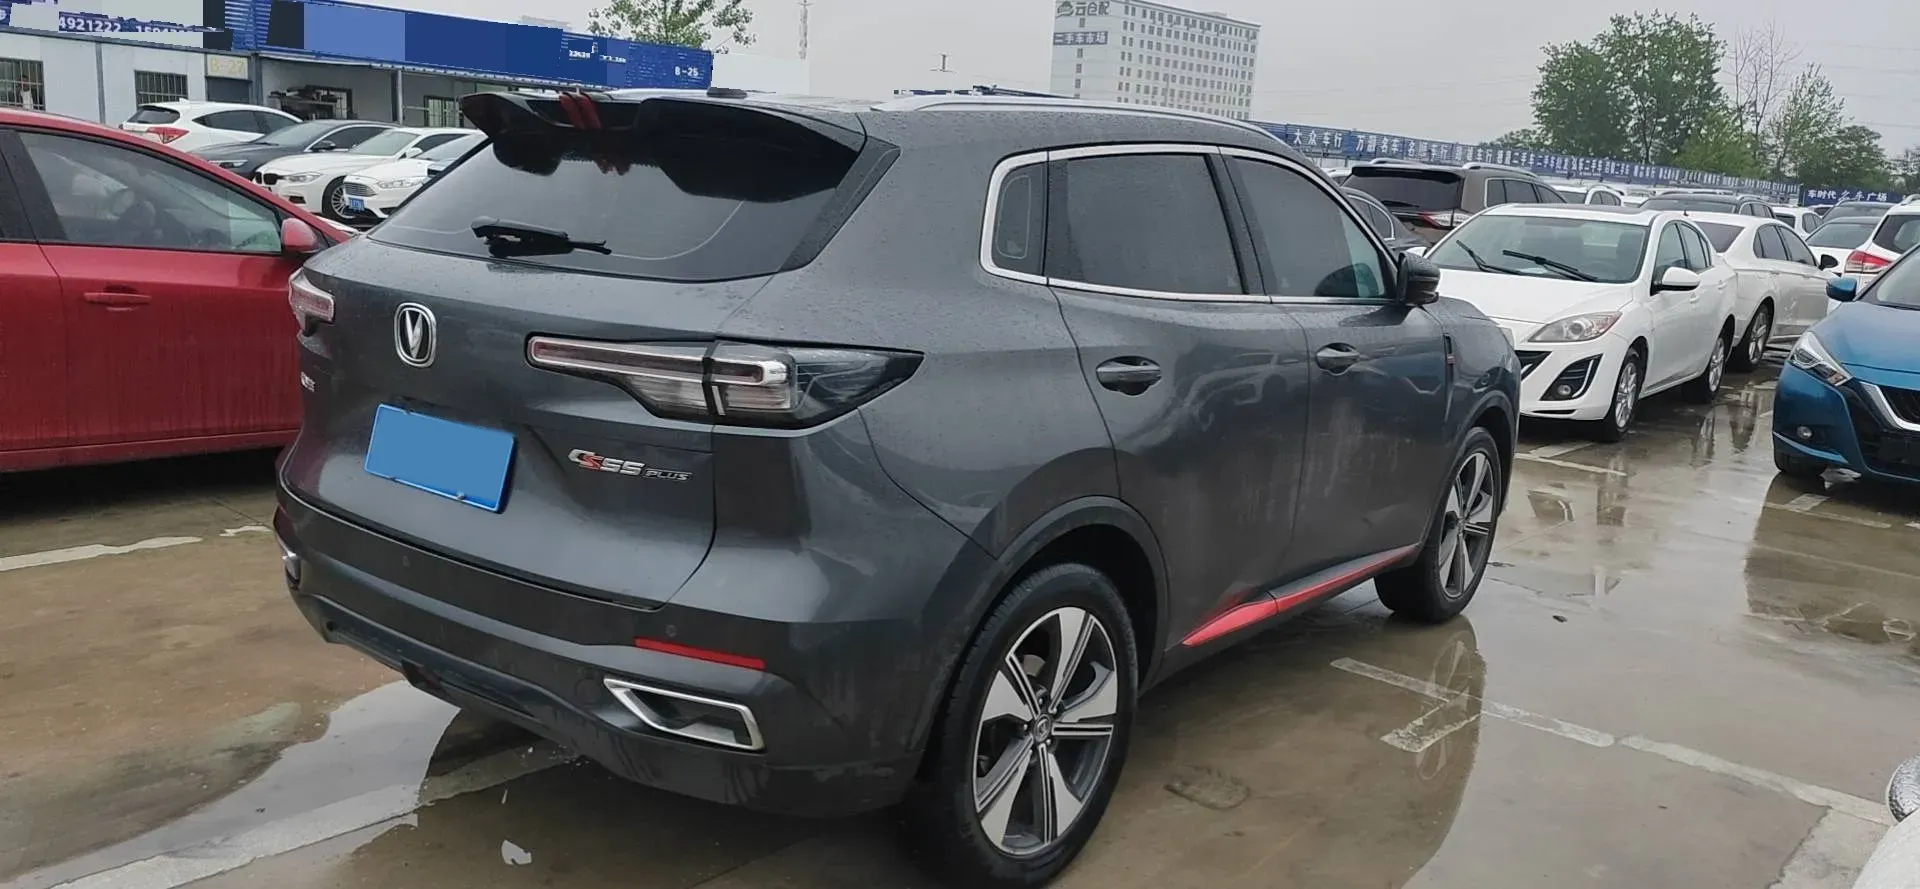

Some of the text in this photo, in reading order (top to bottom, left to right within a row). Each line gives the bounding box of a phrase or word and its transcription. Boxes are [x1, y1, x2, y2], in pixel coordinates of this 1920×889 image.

[1075, 1, 1110, 16] 云仓配
[1055, 31, 1105, 44] 二手车市场
[210, 57, 244, 74] B-27
[1293, 128, 1343, 149] 大众车行
[568, 448, 690, 481] CS55 PLUS
